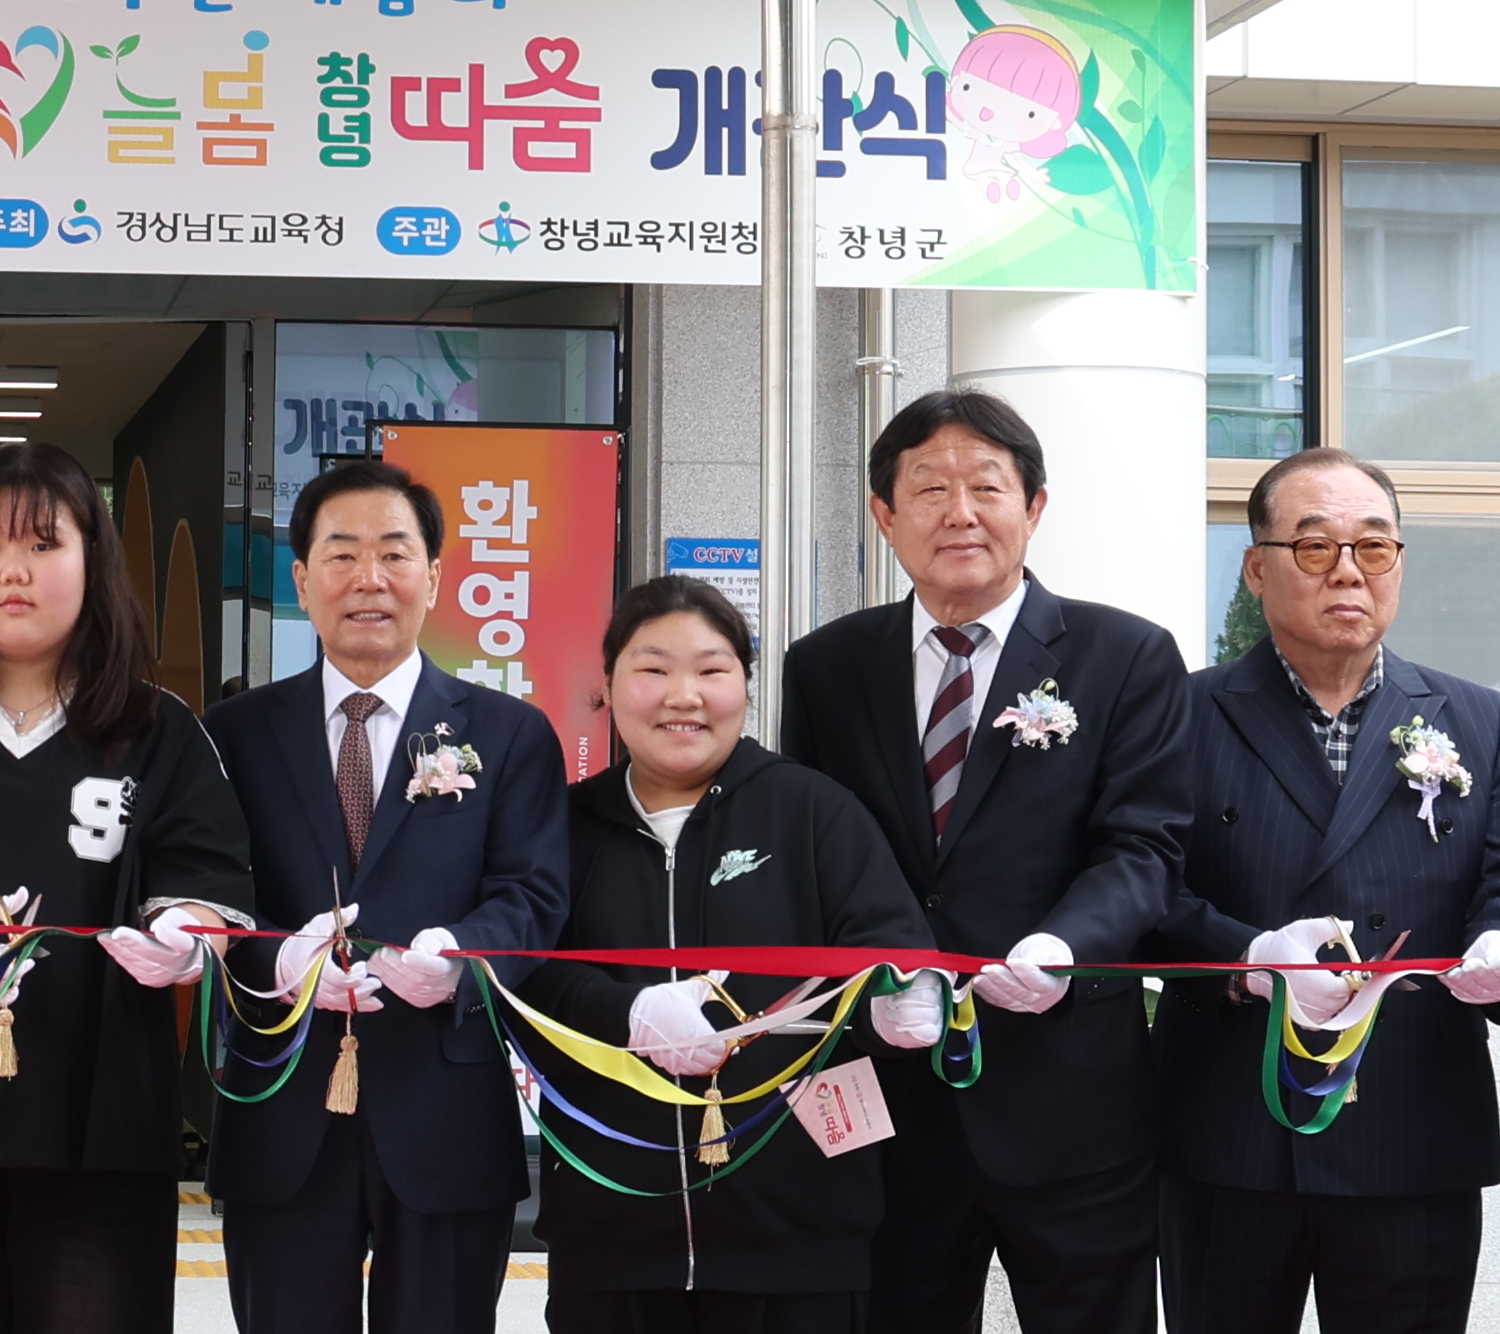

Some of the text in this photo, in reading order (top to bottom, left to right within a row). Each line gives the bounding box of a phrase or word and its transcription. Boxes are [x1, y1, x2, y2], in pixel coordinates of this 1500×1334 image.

[89, 30, 275, 167] 늘봄
[316, 51, 376, 168] 창녕
[390, 36, 602, 173] 따숨
[115, 211, 345, 247] 경상남도교육청
[391, 216, 948, 261] 주관 창녕교육지원청 창녕군
